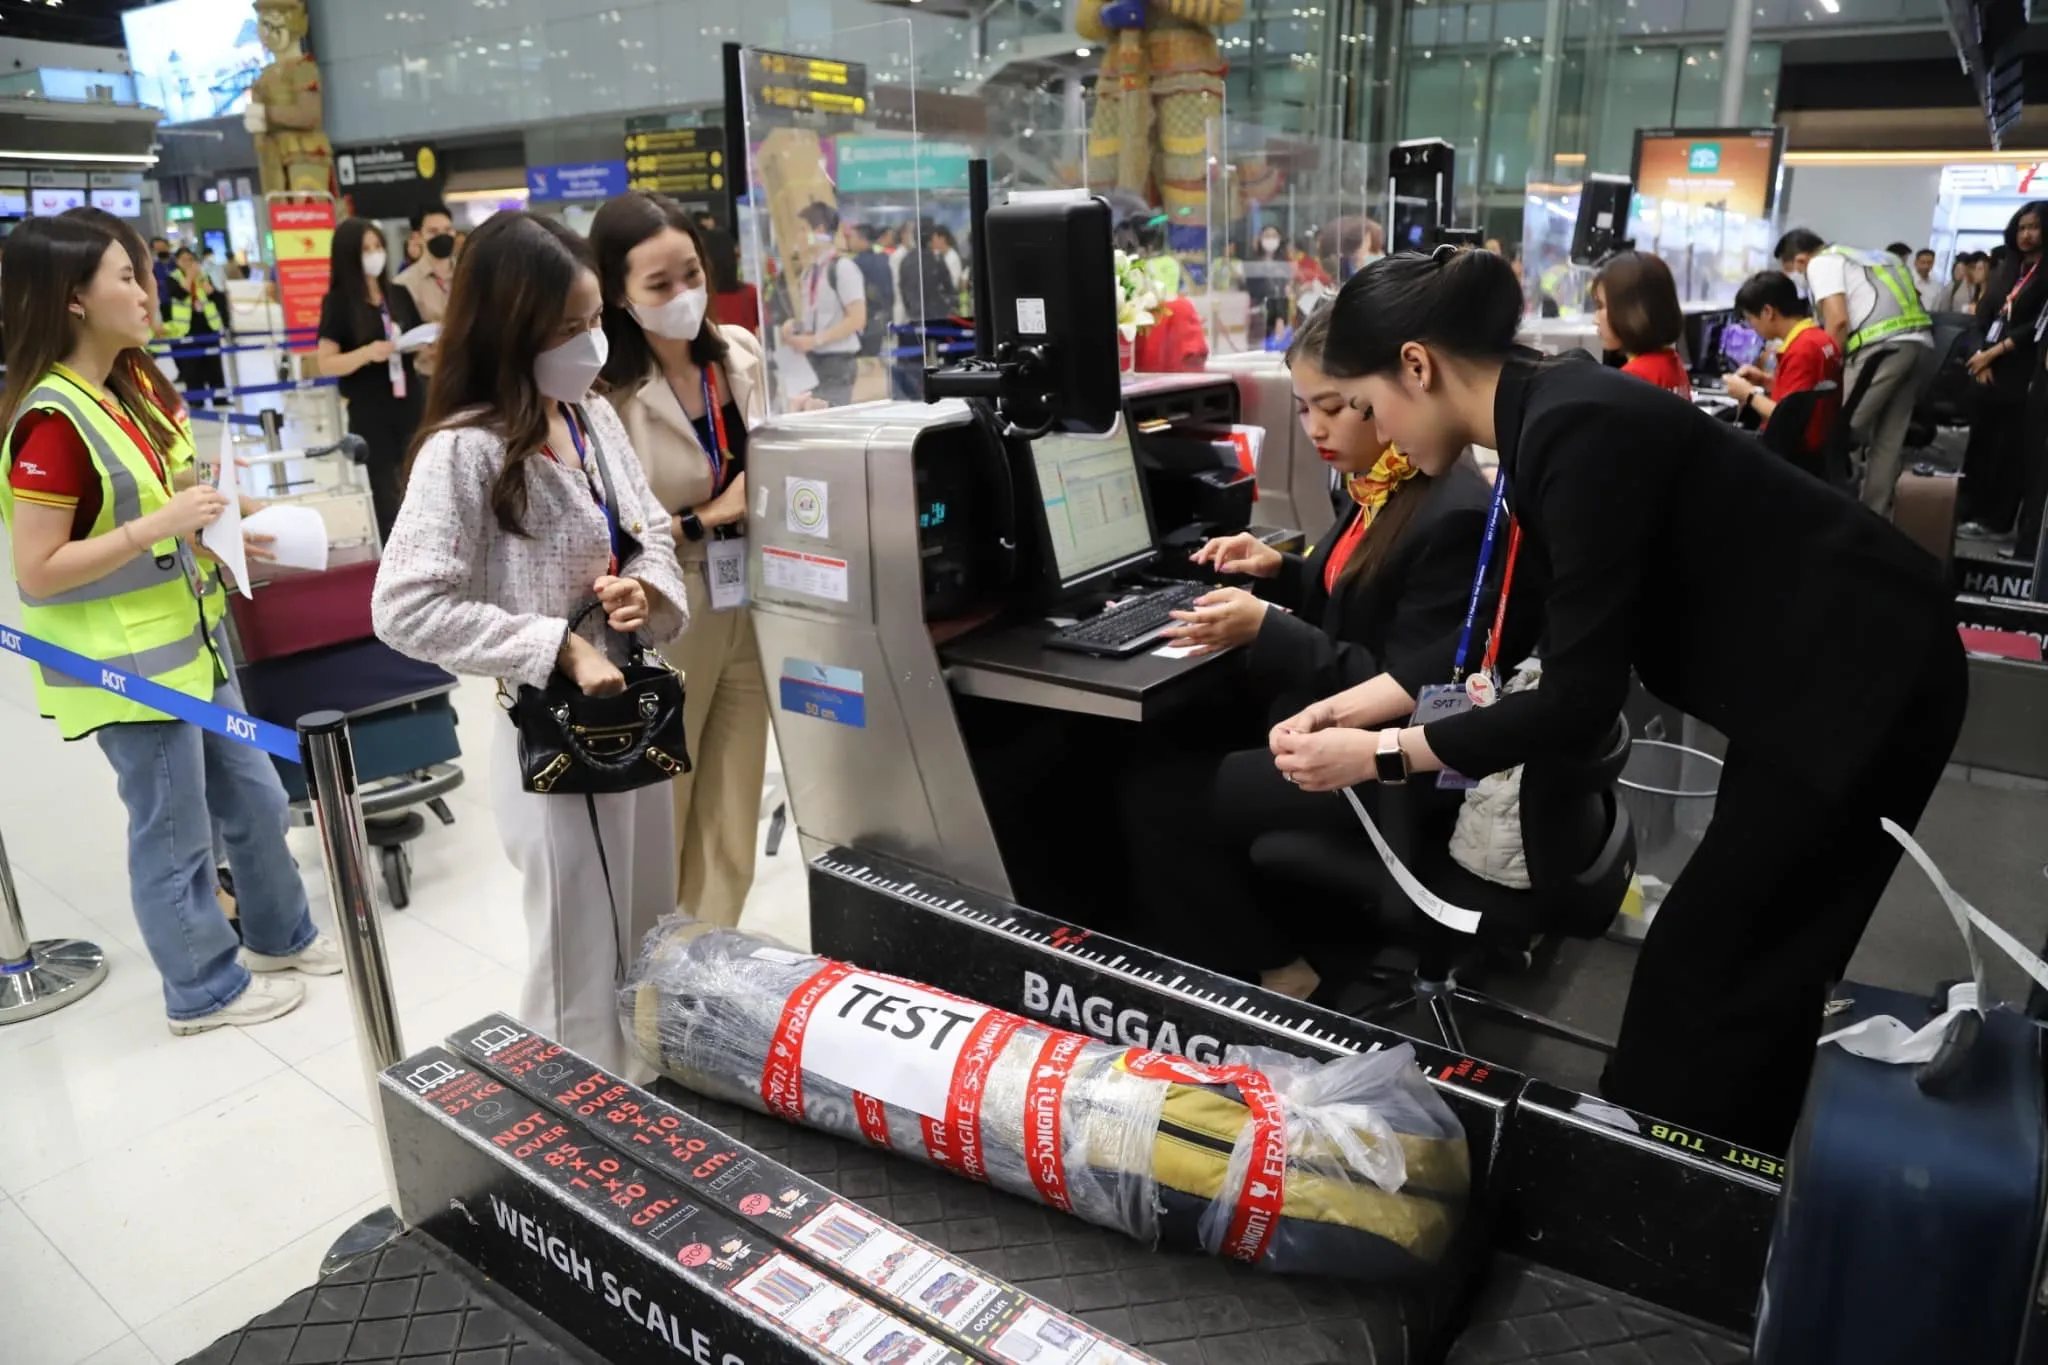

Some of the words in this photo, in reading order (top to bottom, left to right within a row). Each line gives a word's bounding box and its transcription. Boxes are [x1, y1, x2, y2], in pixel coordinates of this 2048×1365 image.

[1, 630, 22, 652] AOT
[101, 669, 126, 693] AOT
[225, 714, 257, 741] AOT
[837, 983, 975, 1051] TEST
[1023, 970, 1236, 1067] BAGGAG
[509, 1060, 537, 1077] 32
[535, 1045, 565, 1062] KG
[444, 1098, 473, 1117] 32
[472, 1082, 504, 1101] KG
[554, 1072, 609, 1106] NOT
[577, 1085, 631, 1117] OVER
[605, 1102, 640, 1124] 85
[491, 1111, 548, 1149] NOT
[513, 1123, 569, 1159] OVER
[632, 1115, 682, 1145] 110
[956, 1096, 980, 1182] FRAGILE
[1650, 1123, 1706, 1153] TUB
[543, 1142, 580, 1168] 85
[672, 1138, 707, 1163] 50
[691, 1150, 738, 1180] cm.
[570, 1158, 620, 1191] 110
[611, 1183, 648, 1209] 50
[740, 1193, 766, 1216] STOP
[631, 1197, 680, 1227] cm.
[678, 1242, 706, 1267] STOP
[488, 1192, 595, 1292] WEIGH
[601, 1271, 711, 1365] SCALE
[972, 1309, 995, 1333] OOG
[992, 1298, 1010, 1317] Lift
